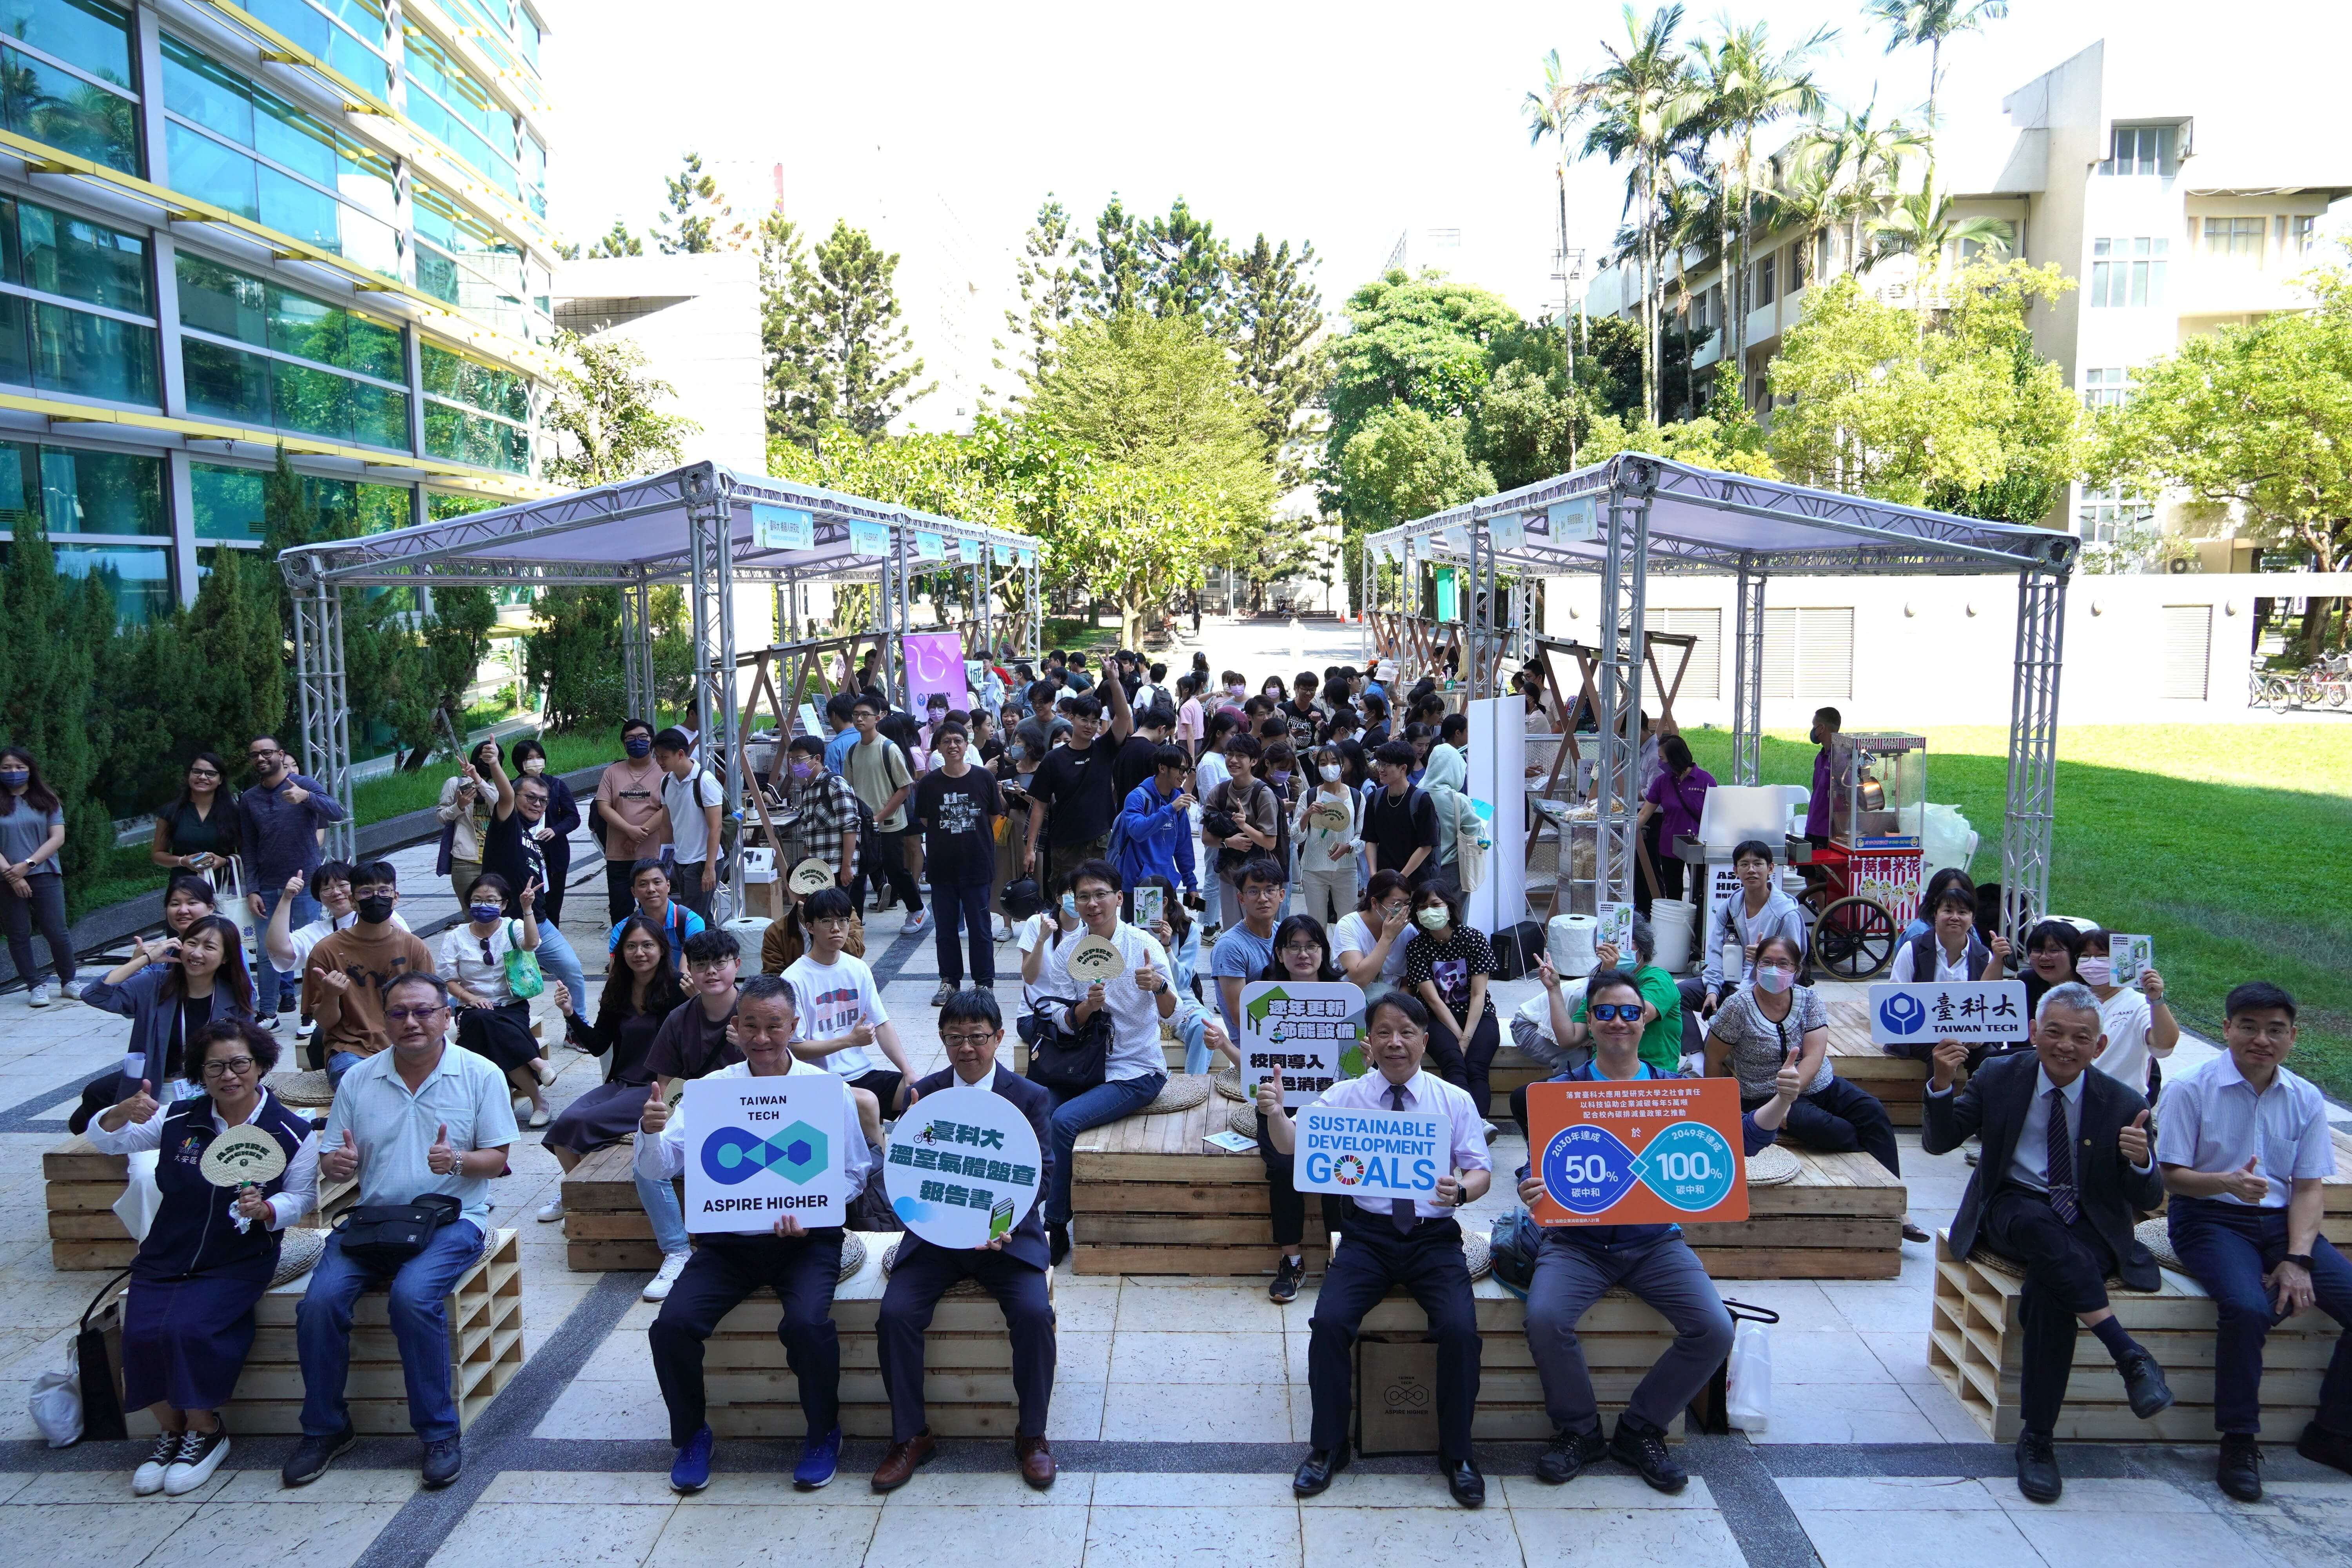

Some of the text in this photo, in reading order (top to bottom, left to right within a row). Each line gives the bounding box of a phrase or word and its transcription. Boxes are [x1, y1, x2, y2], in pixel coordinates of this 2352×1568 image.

[800, 869, 828, 882] ASPIRE
[1077, 948, 1113, 963] ASPIRE
[1082, 955, 1109, 965] HIGHER
[1267, 999, 1345, 1017] 逐年更新
[1931, 993, 2017, 1024] 臺科大
[836, 1008, 858, 1027] UP
[1278, 1021, 1356, 1040] 節能設備
[1932, 1024, 1981, 1033] TAIWAN
[740, 1095, 787, 1105] TAIWAN
[748, 1111, 779, 1120] TECH
[1583, 1109, 1686, 1119] 配合校內碳排減量政策之推動
[931, 1120, 1004, 1151] 臺科大
[1309, 1116, 1436, 1138] SUSTAINABLE
[1631, 1127, 1641, 1138] 於
[1308, 1134, 1436, 1156] DEVELOPMENT
[1552, 1131, 1601, 1157] 2030年達成
[1671, 1129, 1722, 1152] 2049年達成
[174, 1154, 198, 1164] 大安區
[179, 1146, 198, 1155] TAIPEI
[216, 1143, 270, 1161] ASPIRE
[223, 1151, 263, 1164] HIGHER
[1307, 1152, 1436, 1190] GOALS
[1565, 1154, 1619, 1183] 50%
[1656, 1152, 1722, 1181] 100%
[920, 1180, 994, 1211] 報告書
[1571, 1188, 1600, 1198] 碳中和
[1676, 1185, 1704, 1195] 碳中和
[703, 1195, 828, 1212] ASPIRE HIGHER
